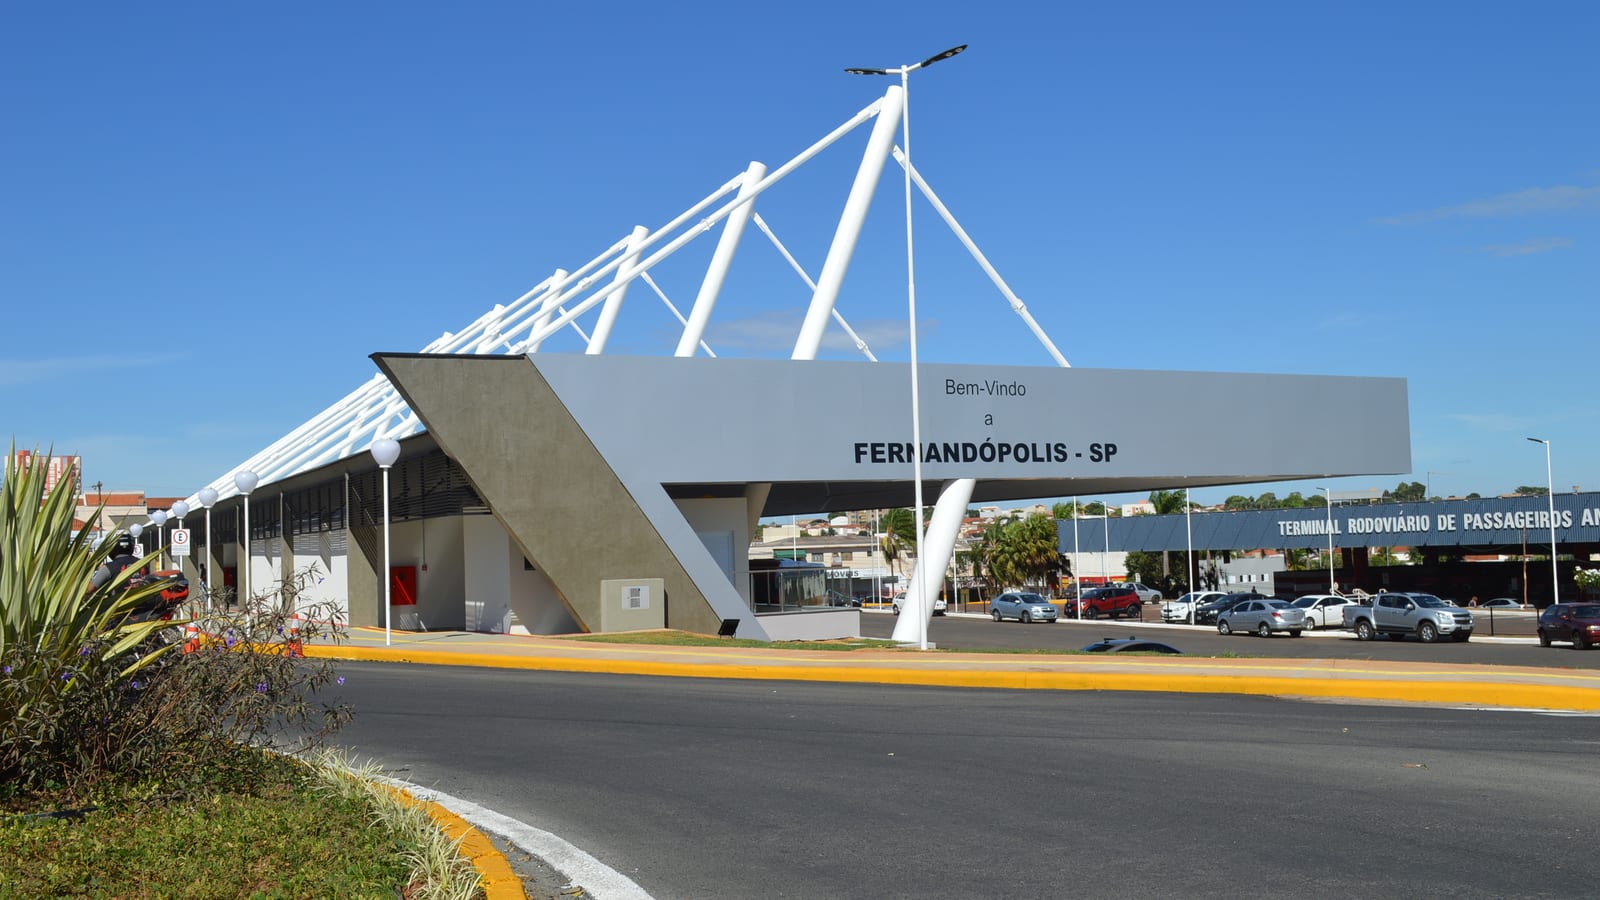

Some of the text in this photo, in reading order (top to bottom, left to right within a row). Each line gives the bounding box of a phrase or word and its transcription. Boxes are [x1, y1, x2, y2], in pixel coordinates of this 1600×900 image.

[945, 378, 1027, 396] Bem-Vindo
[984, 413, 993, 426] a
[854, 437, 1068, 464] FERNANDÓPOLIS
[1089, 443, 1118, 463] SP
[1278, 519, 1342, 536] TERMINAL
[1348, 510, 1430, 534] RODOVIÁRIO
[1437, 514, 1456, 531] DE
[1463, 510, 1573, 531] PASSAGEIROS
